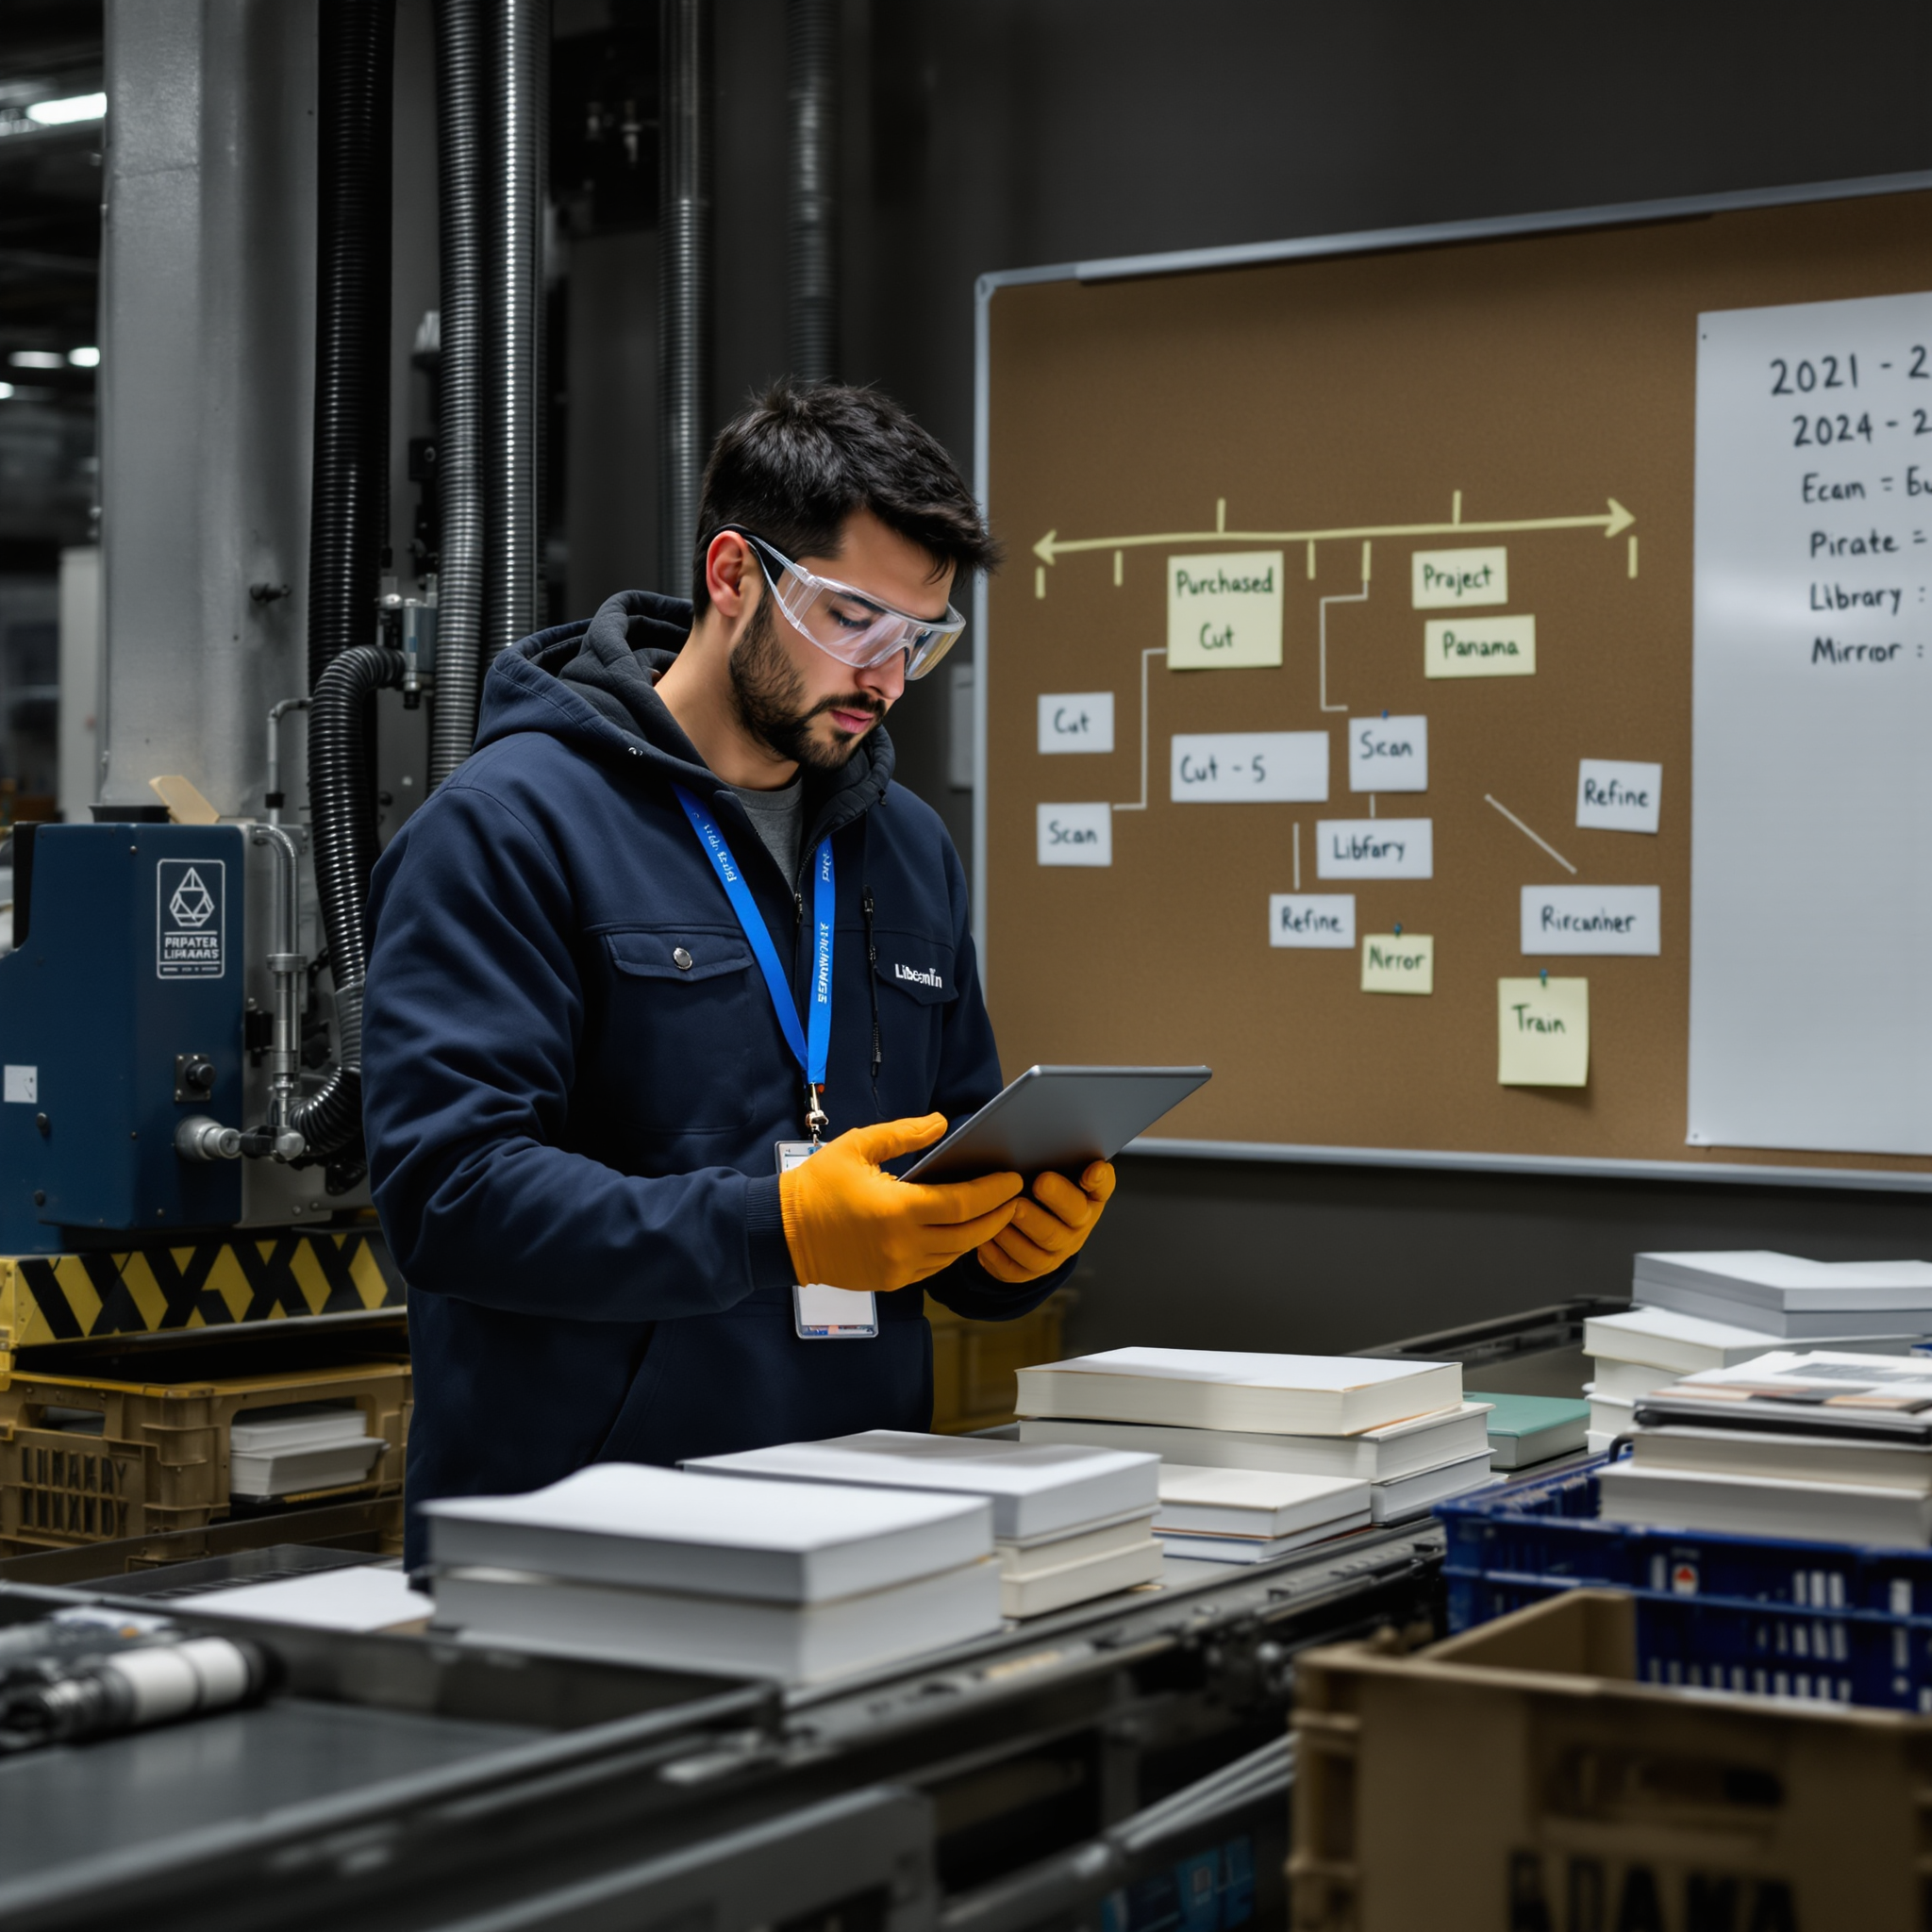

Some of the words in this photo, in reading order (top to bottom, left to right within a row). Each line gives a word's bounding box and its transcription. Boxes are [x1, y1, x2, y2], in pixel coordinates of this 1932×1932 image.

[1770, 353, 1858, 396] 2021
[1792, 412, 1874, 448] 2024
[1809, 529, 1899, 558] Pirate
[1175, 565, 1274, 599] Purchased
[1810, 583, 1903, 616] Library
[1199, 622, 1235, 651] Cut
[1442, 630, 1520, 658] Panama
[1811, 637, 1902, 664] Mirror
[1053, 708, 1090, 734] Cut
[1359, 730, 1413, 760] Scan
[1179, 755, 1218, 784] Cut
[1584, 778, 1648, 808] Refine
[1048, 820, 1098, 845] Scan
[1281, 906, 1344, 934] Refine
[1511, 1003, 1565, 1034] Train
